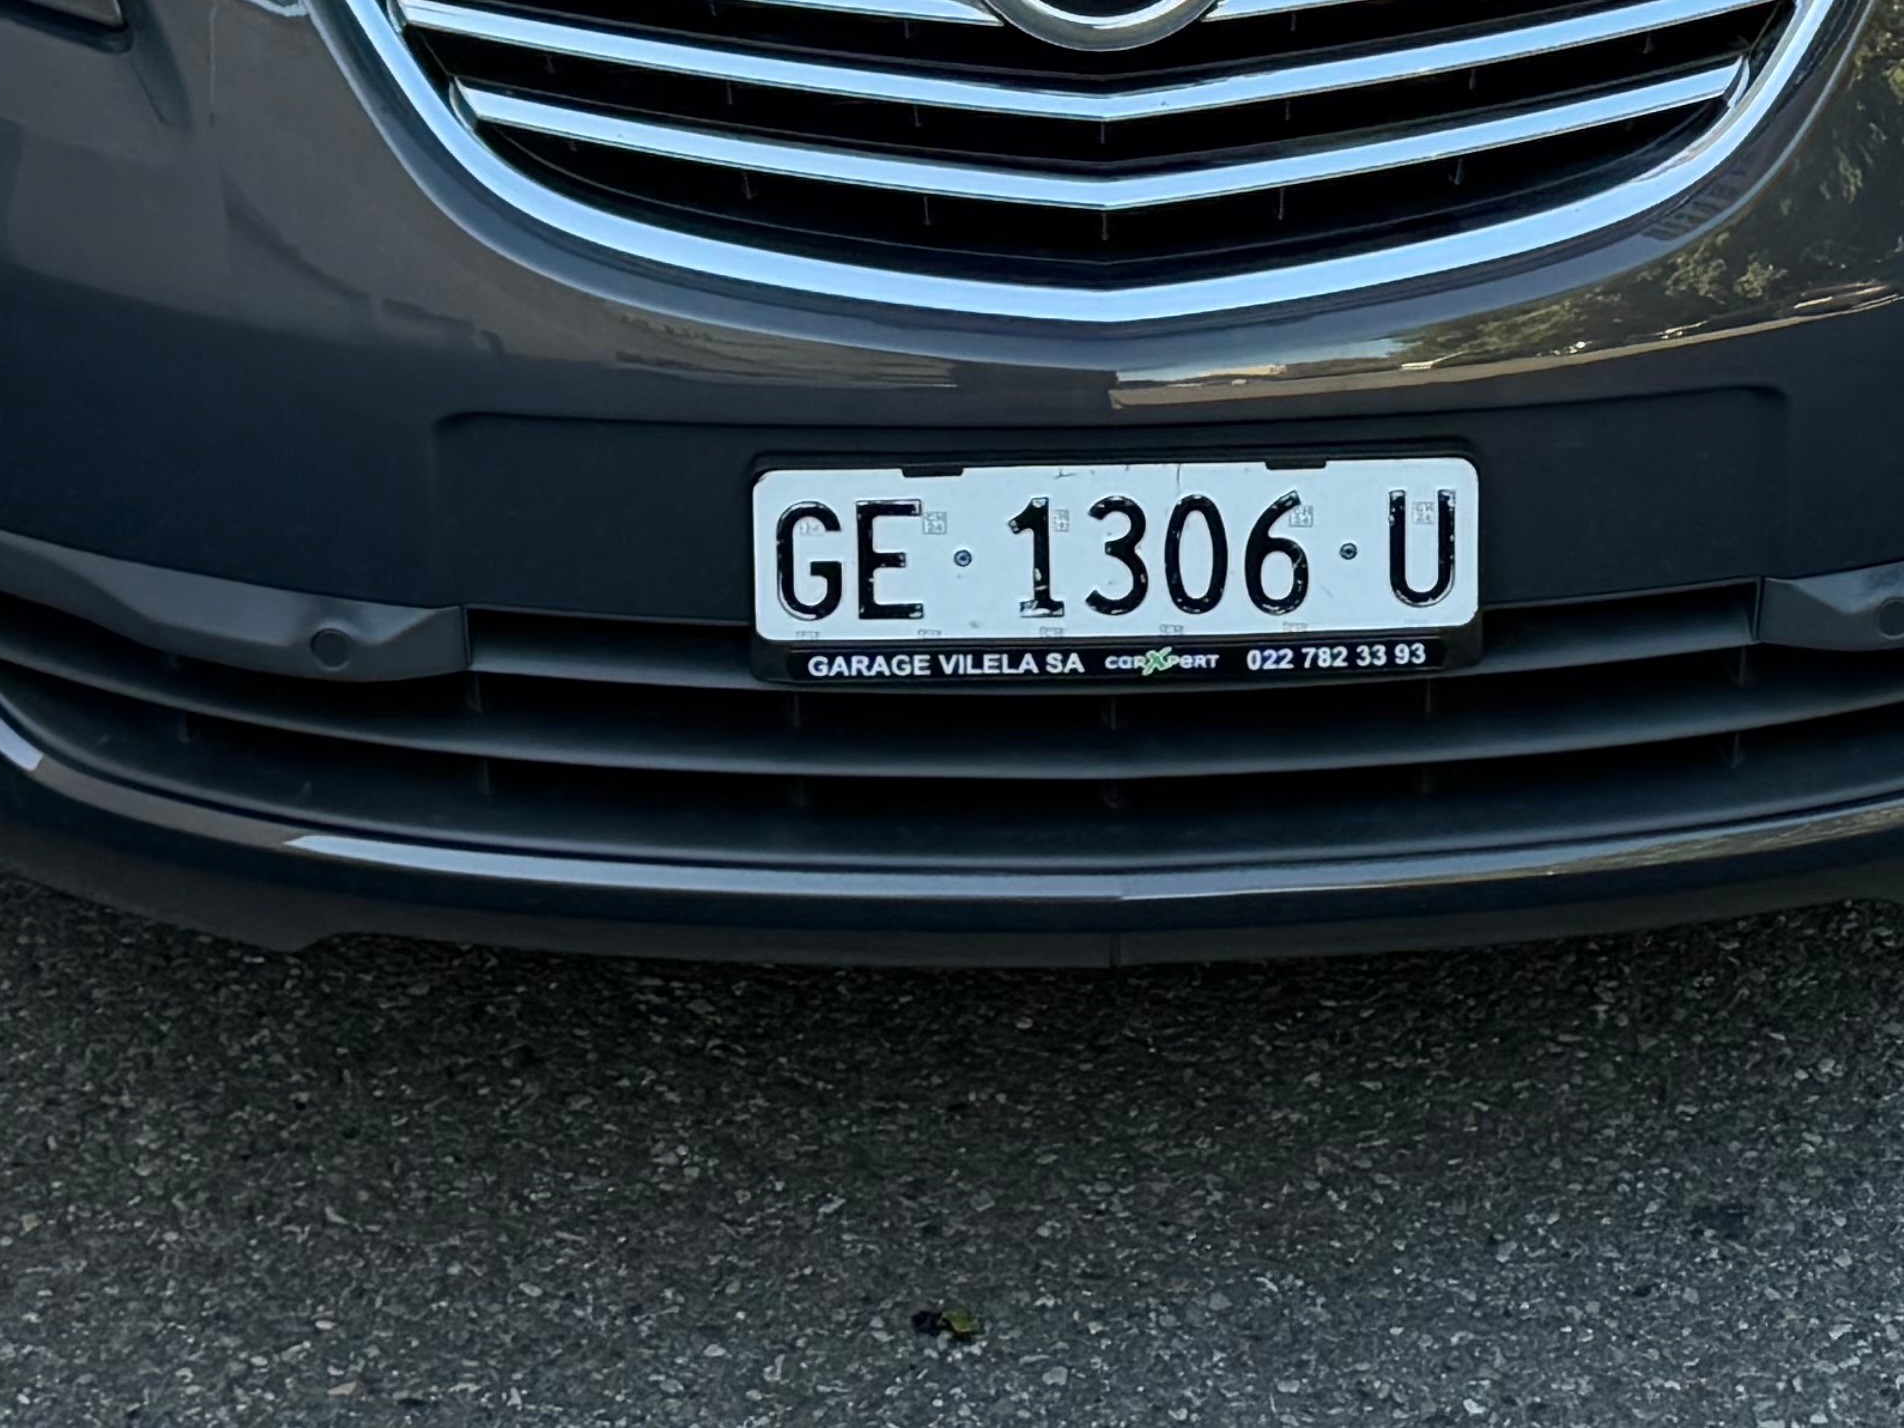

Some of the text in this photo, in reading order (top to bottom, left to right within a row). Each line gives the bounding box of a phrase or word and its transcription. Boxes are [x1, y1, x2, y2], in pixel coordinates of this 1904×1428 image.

[775, 488, 1457, 622] GE 1306 U
[807, 654, 932, 677] GARAGE
[938, 652, 1039, 675] VILELA
[1045, 652, 1086, 674] SA
[1246, 647, 1294, 671] 022
[1301, 645, 1349, 669] 782
[1356, 644, 1387, 666] 33
[1394, 642, 1426, 665] 93
